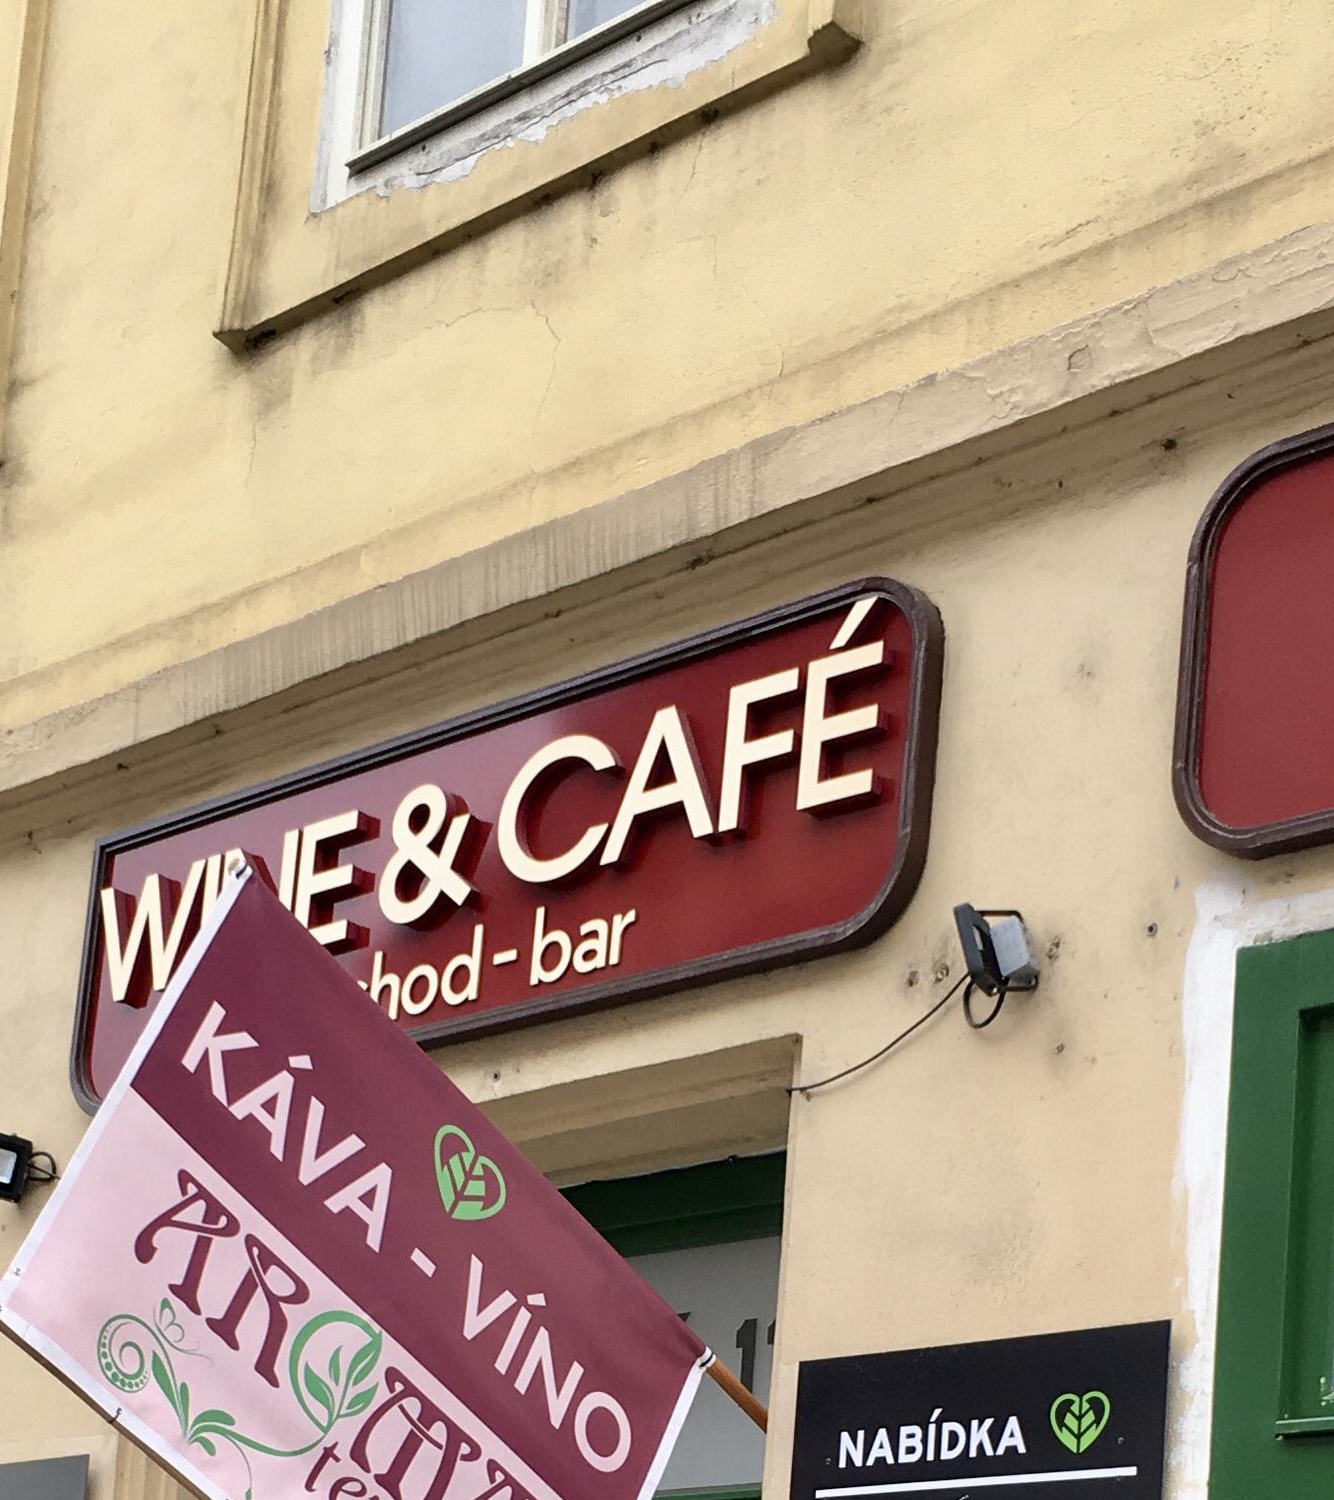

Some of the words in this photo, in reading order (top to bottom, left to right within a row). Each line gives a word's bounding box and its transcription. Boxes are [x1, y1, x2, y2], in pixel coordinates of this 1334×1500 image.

[378, 783, 473, 925] &
[497, 596, 887, 886] CAFÉ
[530, 906, 636, 986] bar
[181, 1001, 394, 1255] KÁVA
[463, 1253, 633, 1474] VÍNO
[838, 1408, 1027, 1468] NABÍDKA
